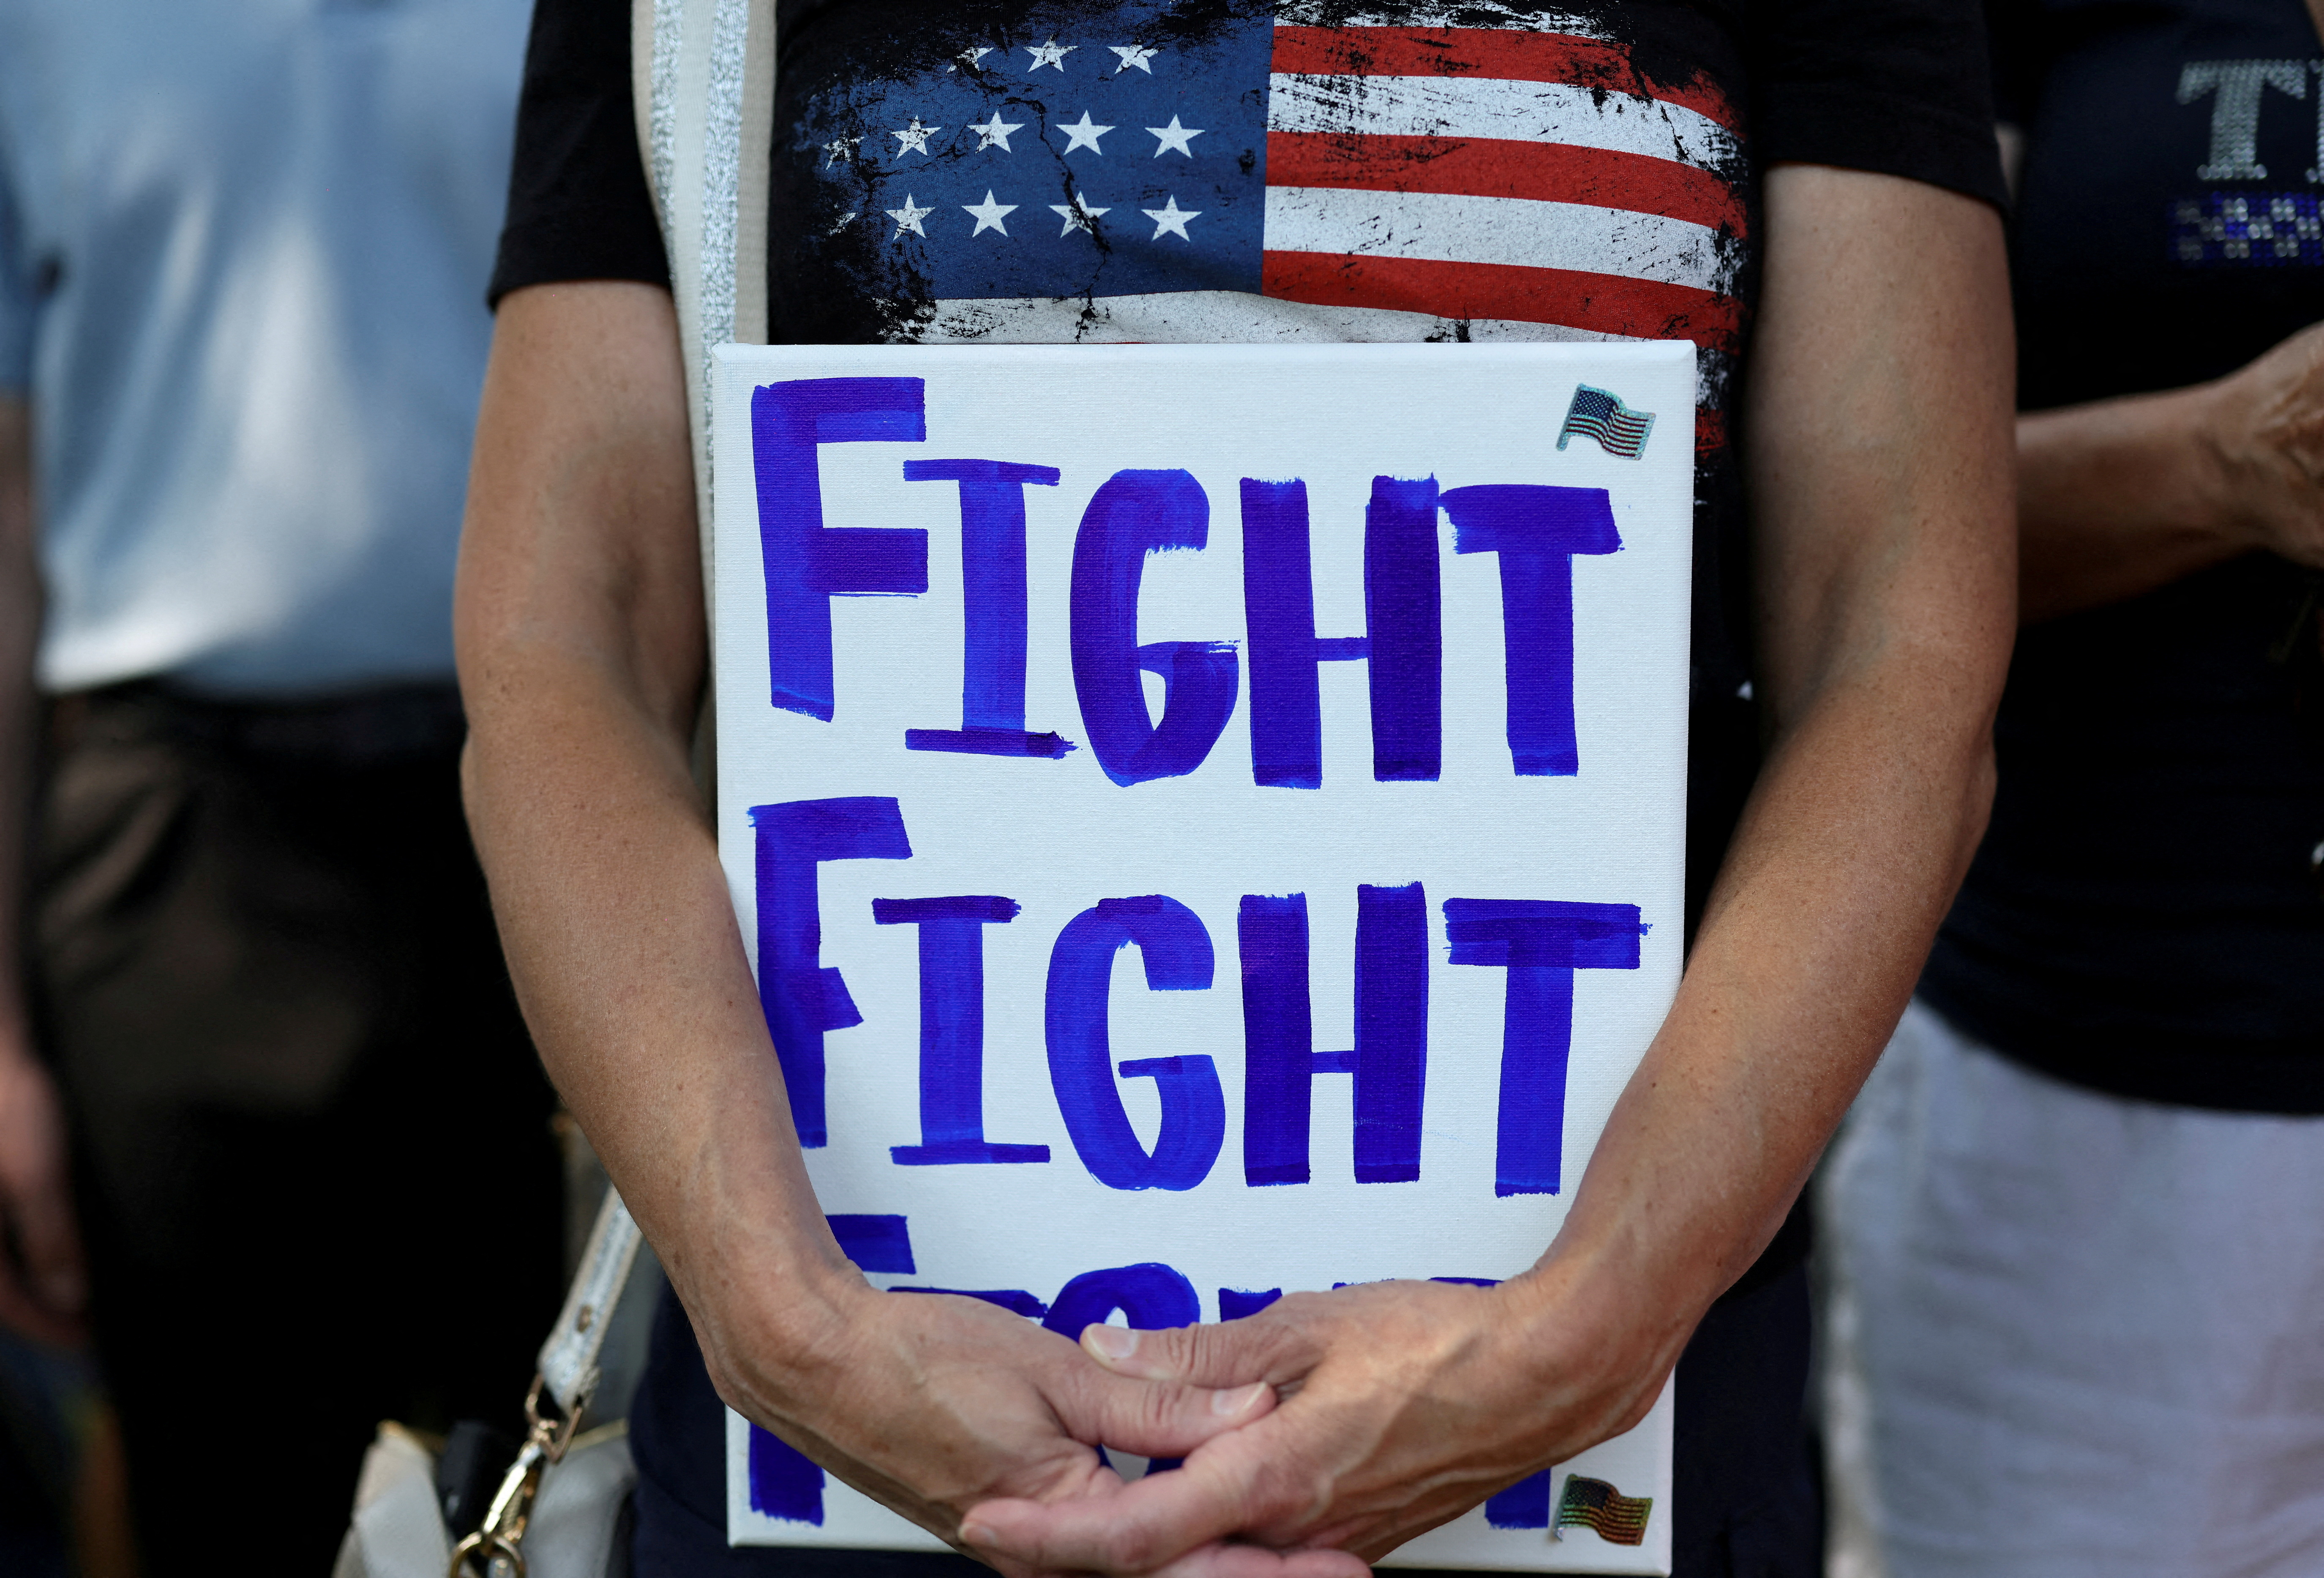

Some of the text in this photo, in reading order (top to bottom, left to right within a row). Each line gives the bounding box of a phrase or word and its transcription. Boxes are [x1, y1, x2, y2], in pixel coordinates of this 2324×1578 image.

[2175, 58, 2324, 183] T
[750, 376, 1625, 789] FIGHT
[747, 796, 1653, 1199] FIGHT
